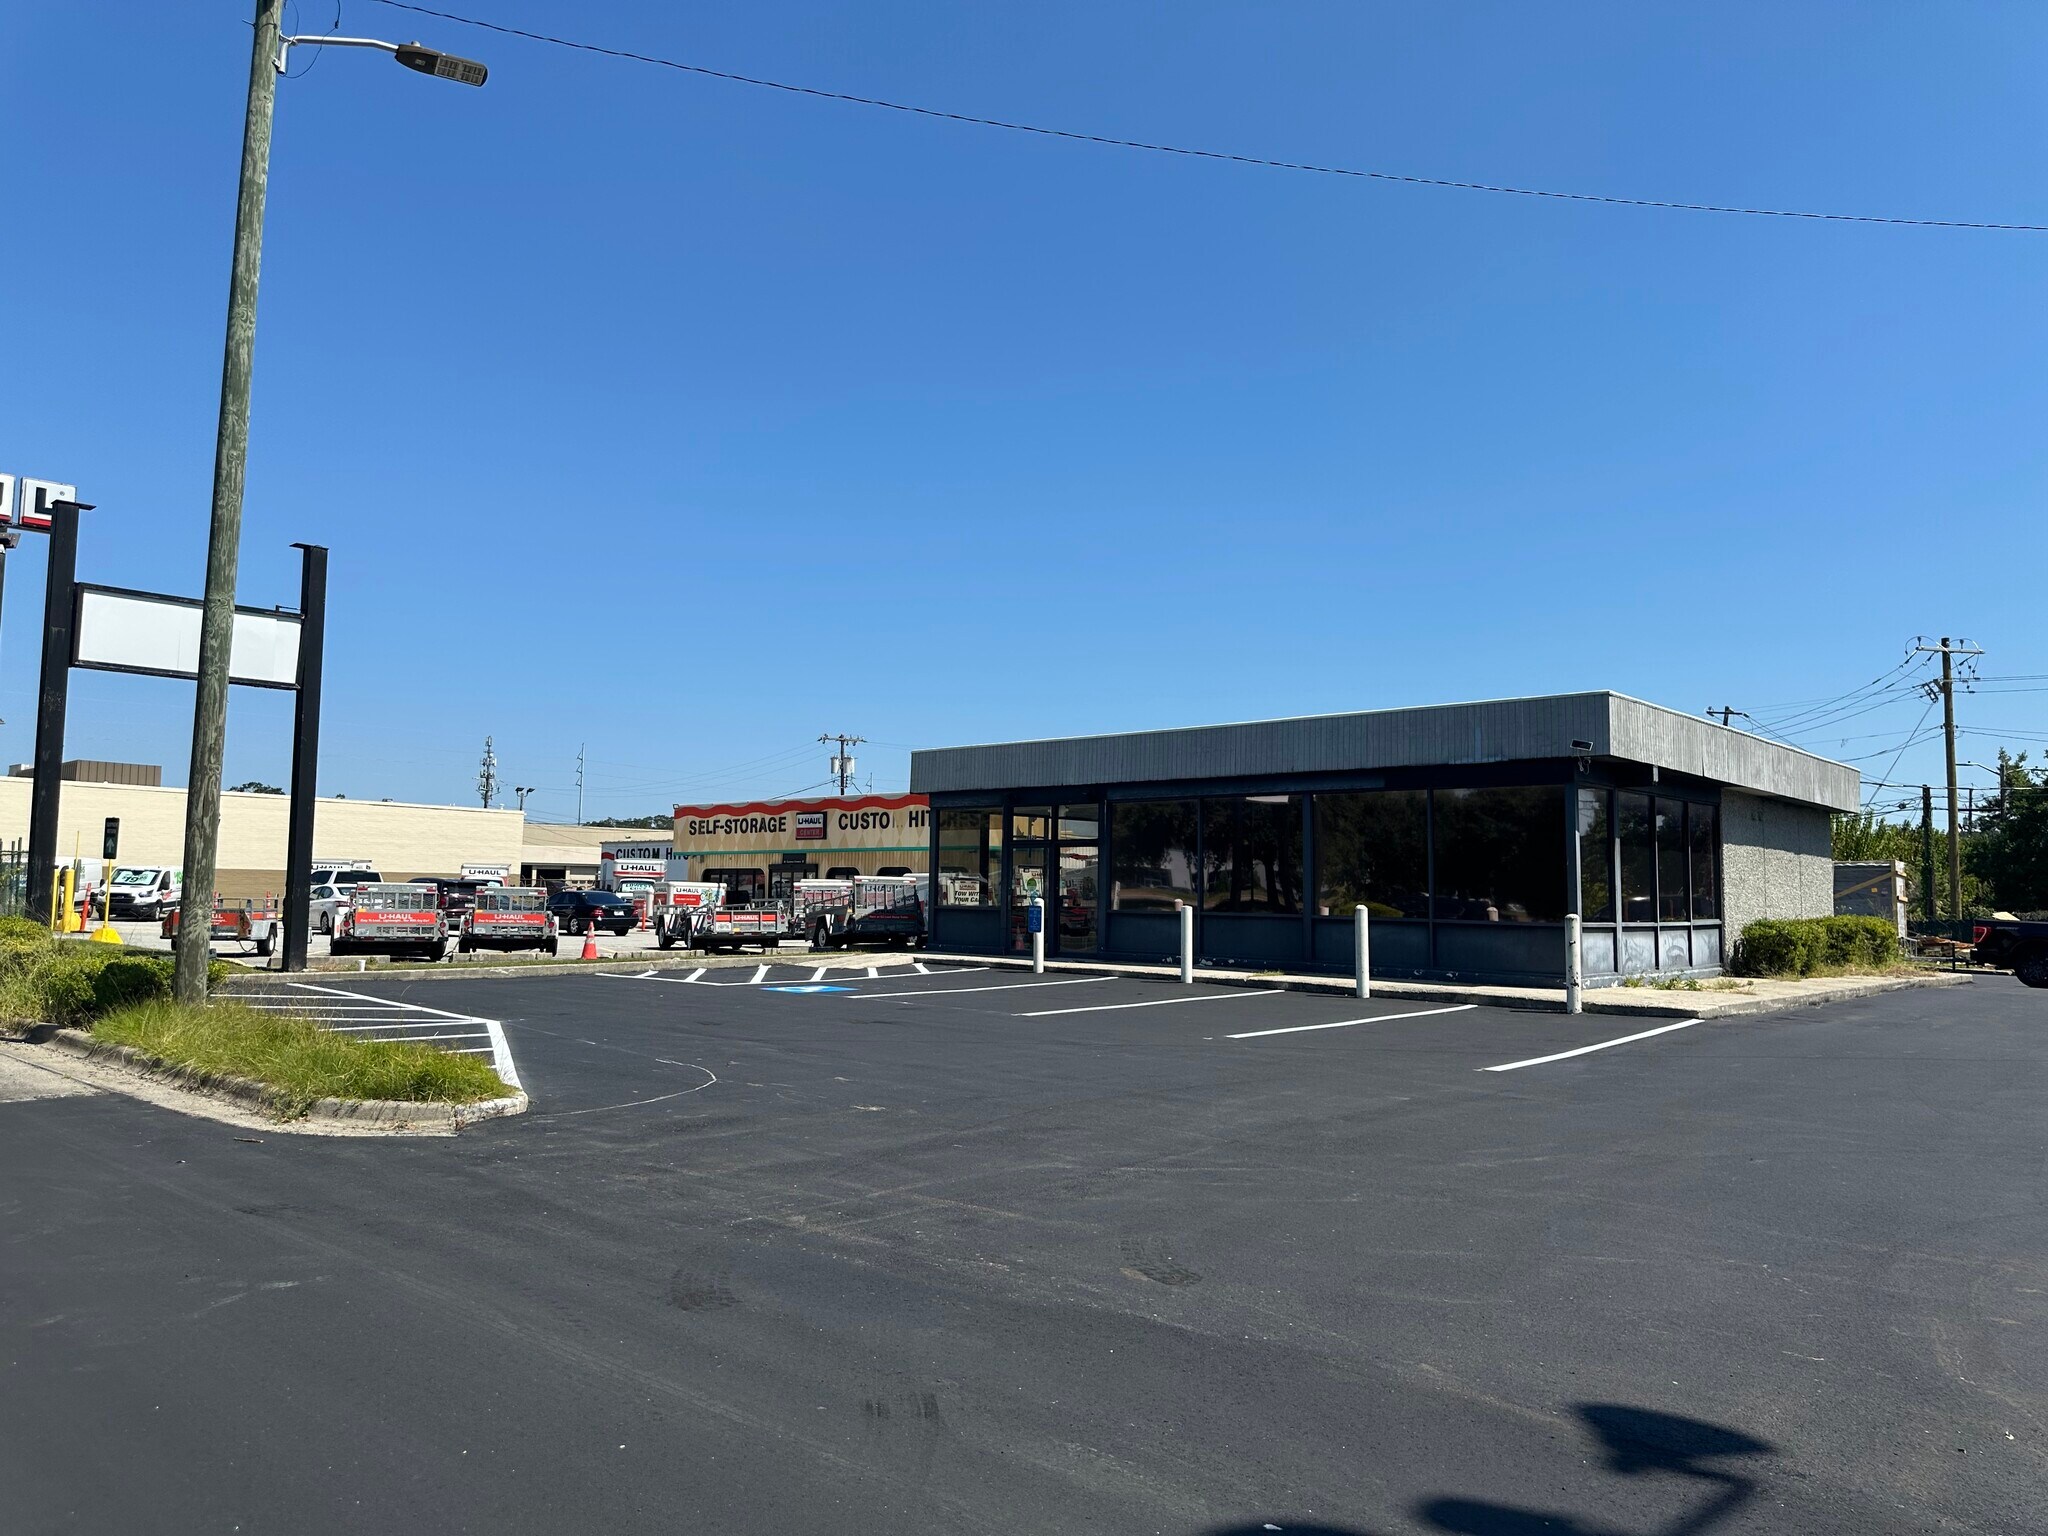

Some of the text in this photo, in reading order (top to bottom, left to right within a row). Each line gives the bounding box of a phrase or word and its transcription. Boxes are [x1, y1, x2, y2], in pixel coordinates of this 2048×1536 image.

[689, 816, 787, 836] SELF-STORAGE
[797, 817, 822, 825] U-HAUL
[838, 811, 903, 831] CUSTO
[615, 847, 660, 860] CUSTOM
[620, 864, 657, 872] U-HAUL
